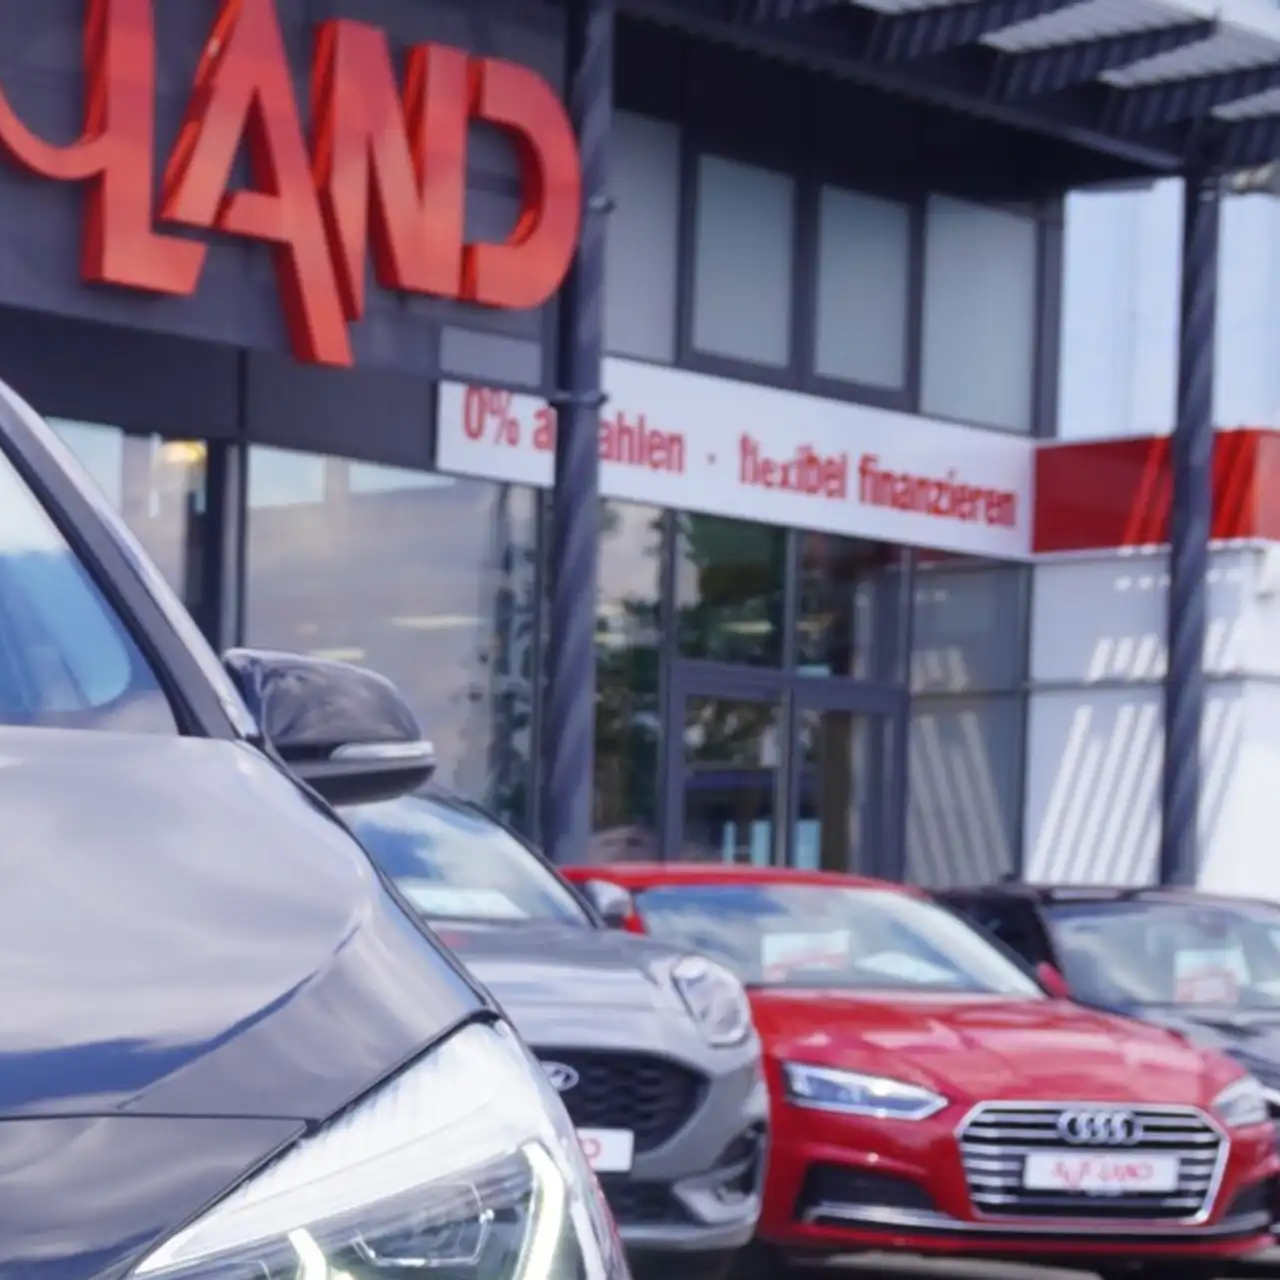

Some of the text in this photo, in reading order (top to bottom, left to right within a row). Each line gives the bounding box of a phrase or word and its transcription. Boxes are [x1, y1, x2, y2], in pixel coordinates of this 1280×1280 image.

[463, 383, 1018, 528] 0% aahlen flexibel finanzieren
